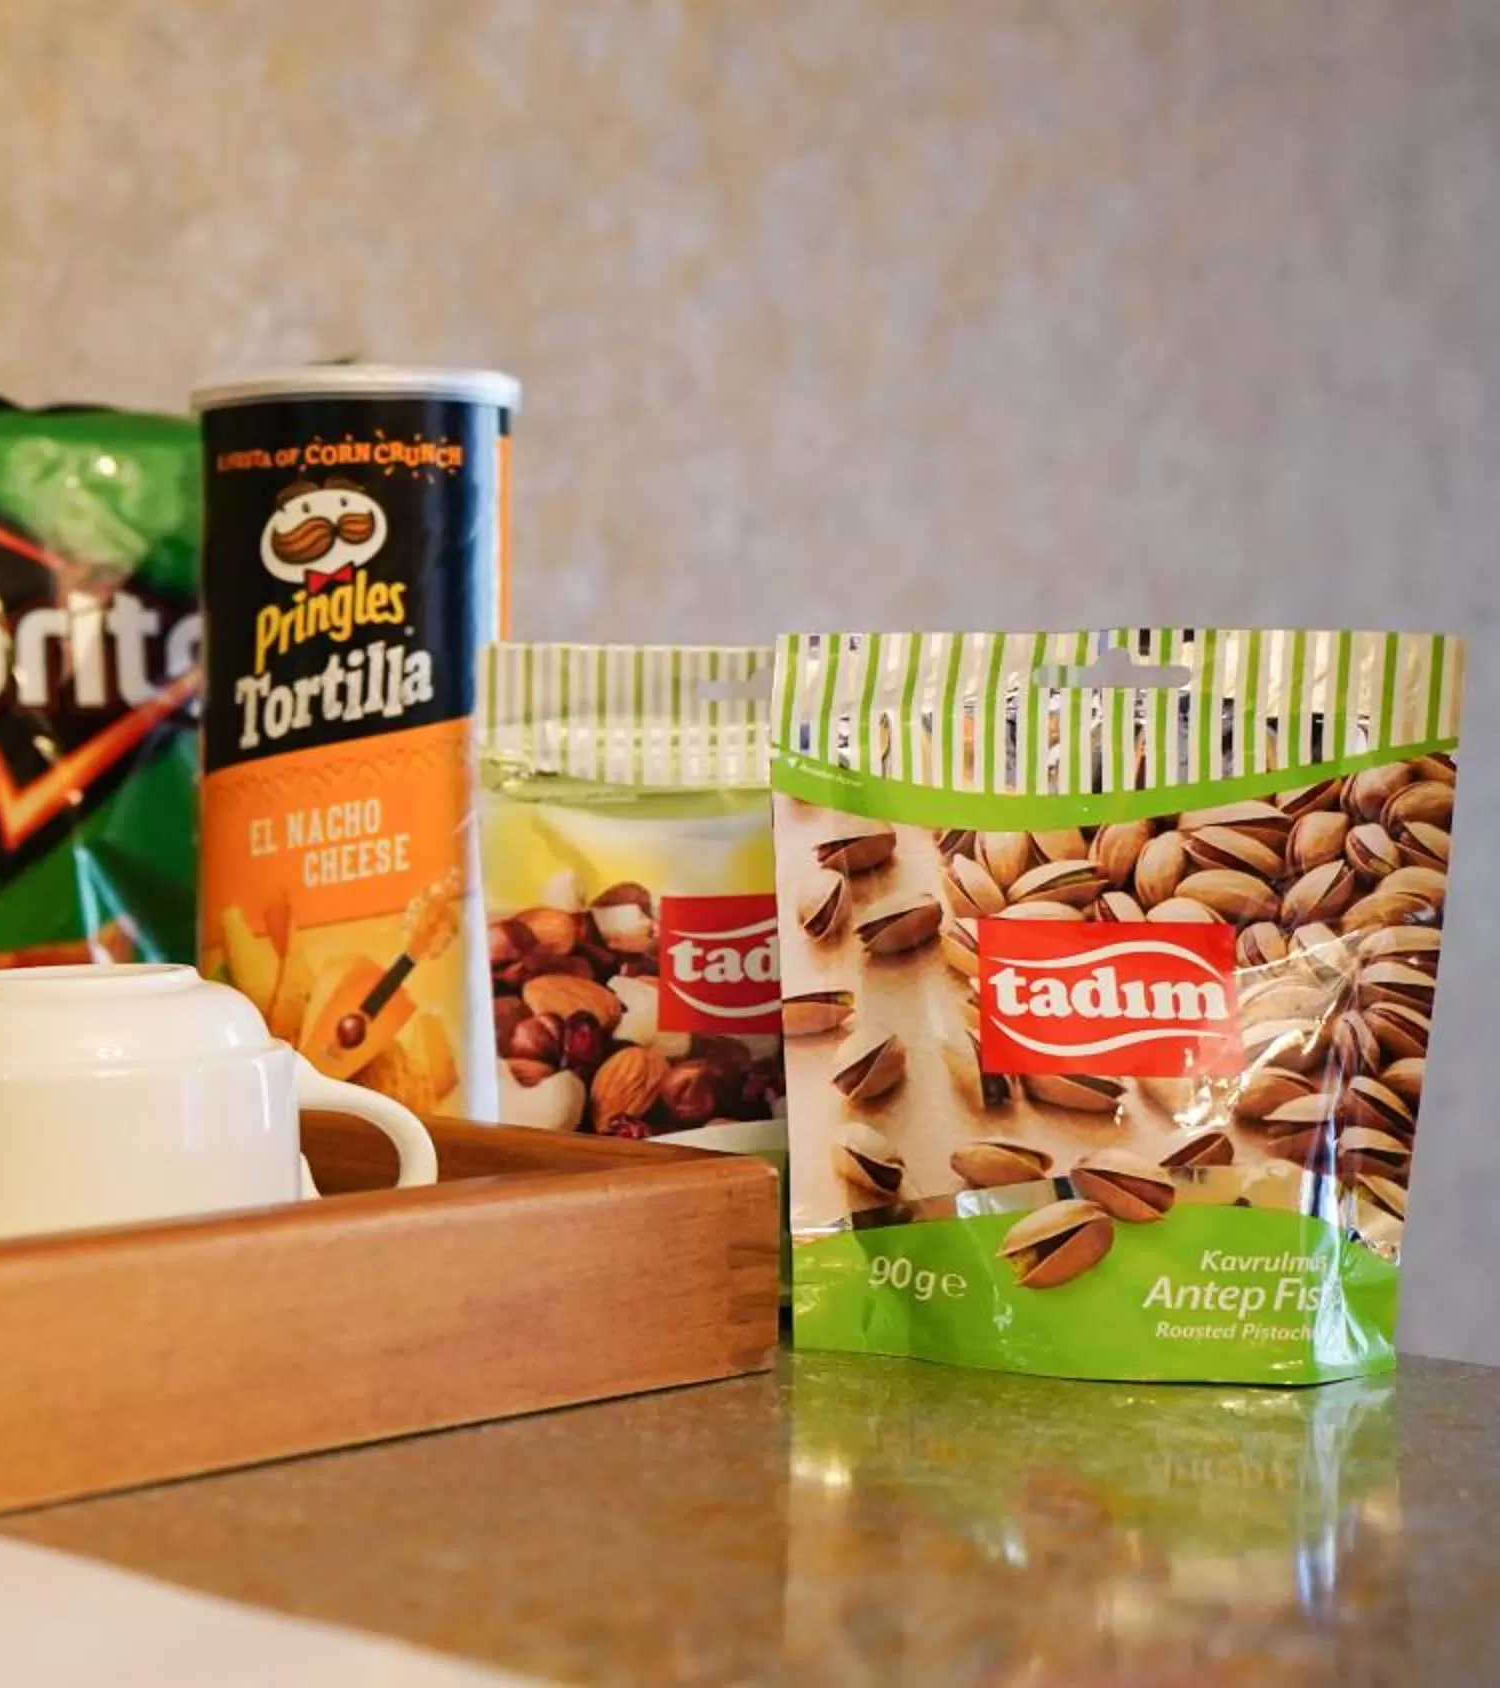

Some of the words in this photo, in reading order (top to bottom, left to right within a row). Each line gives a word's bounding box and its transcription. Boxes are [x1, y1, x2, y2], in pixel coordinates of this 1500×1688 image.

[275, 448, 299, 467] OF
[304, 441, 371, 466] CORN
[374, 440, 464, 468] CRUNCH
[255, 569, 408, 675] Pringles
[235, 640, 434, 750] Tortilla
[250, 817, 279, 857] EL
[286, 797, 382, 849] NACHO
[303, 834, 411, 888] CHEESE
[667, 935, 780, 983] tad
[1142, 1275, 1266, 1320] Antep
[1155, 1322, 1237, 1341] Roasted
[1242, 1322, 1313, 1342] Pistach
